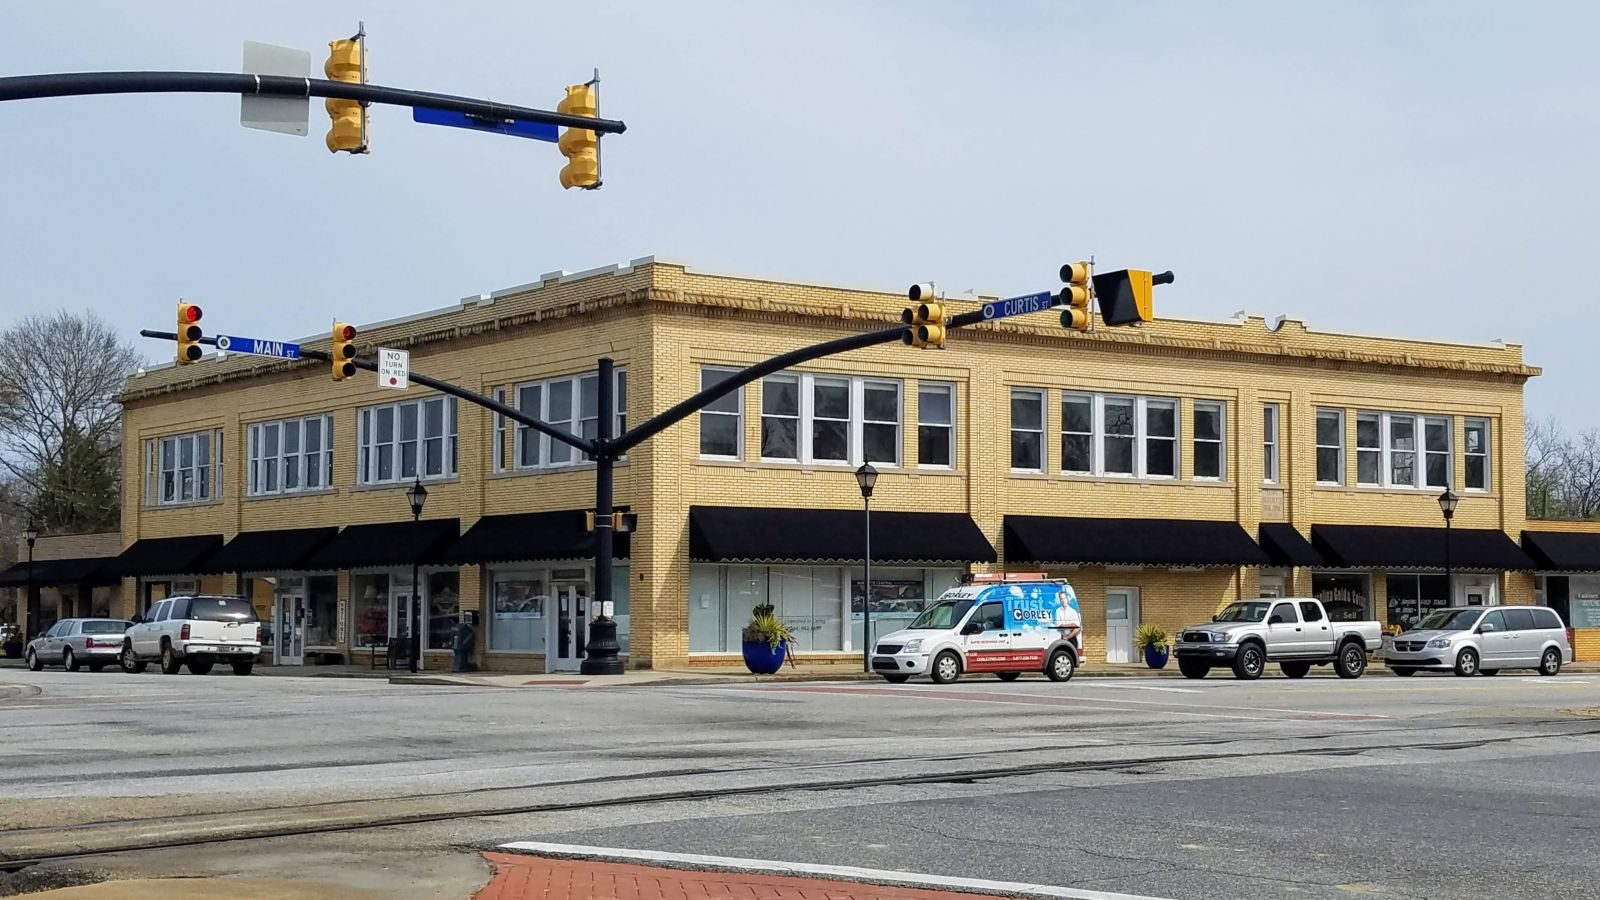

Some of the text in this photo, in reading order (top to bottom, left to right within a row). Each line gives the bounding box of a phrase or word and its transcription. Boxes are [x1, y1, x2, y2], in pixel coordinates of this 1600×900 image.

[1004, 296, 1049, 316] CURTIS ST
[253, 340, 295, 358] MAIN ST
[387, 352, 401, 361] NO
[385, 360, 403, 369] TURN
[381, 368, 406, 377] ON RED
[1005, 597, 1043, 611] Trust
[1013, 609, 1052, 620] CORLEY
[1343, 611, 1357, 619] Sell
